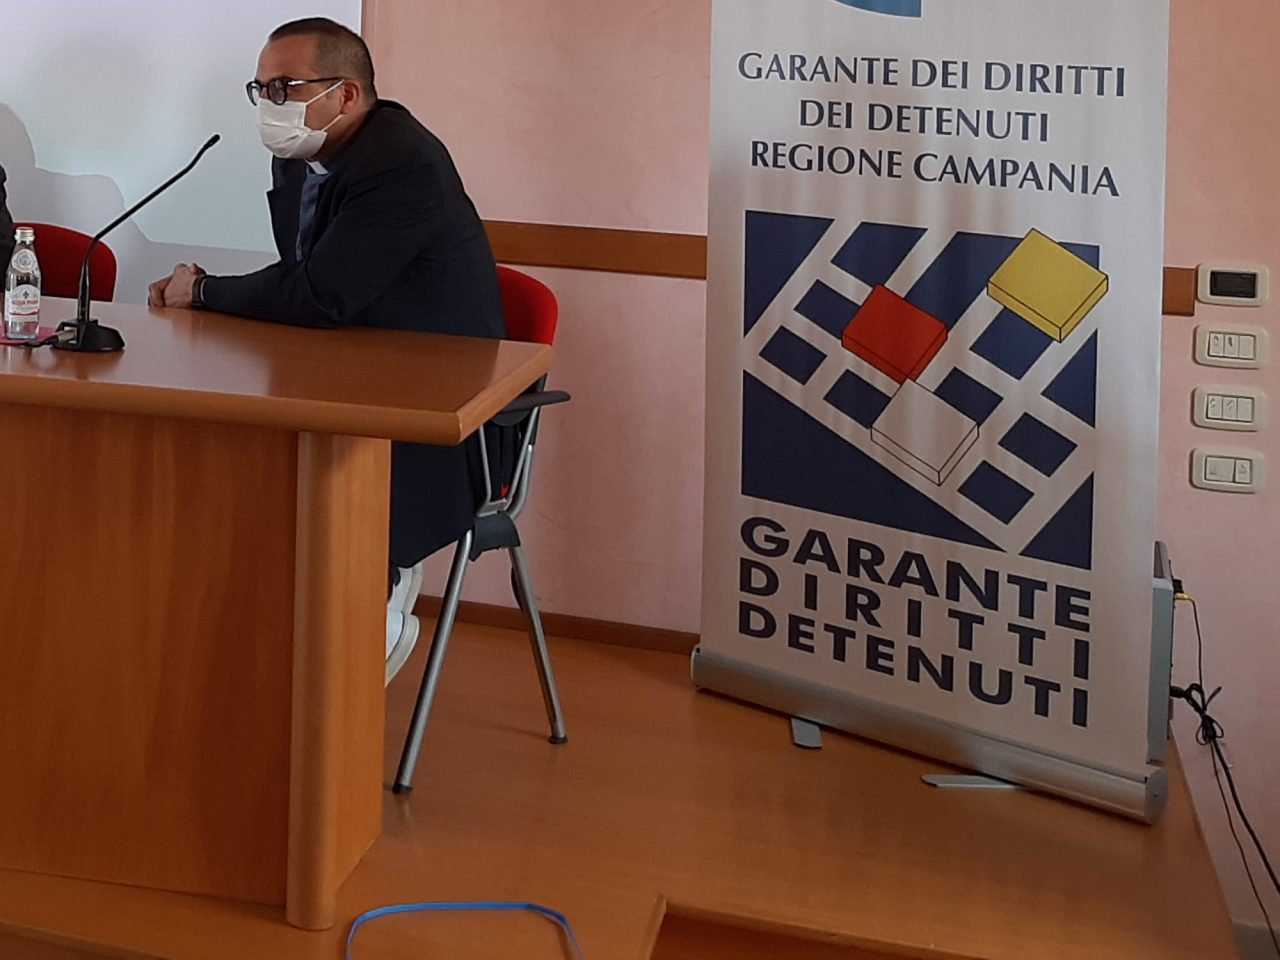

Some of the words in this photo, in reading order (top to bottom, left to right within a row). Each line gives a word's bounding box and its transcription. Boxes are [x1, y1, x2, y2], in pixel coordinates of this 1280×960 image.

[738, 52, 899, 86] GARANTE
[911, 59, 970, 89] DEI
[984, 62, 1125, 97] DIRITTI
[800, 99, 853, 129] DEI
[868, 103, 1048, 142] DETENUTI
[751, 140, 903, 179] REGIONE
[913, 152, 1120, 197] CAMPANIA
[738, 556, 1090, 681] DIRITTI
[739, 516, 1092, 634] GARANTE
[738, 600, 1089, 729] DETENUTI
